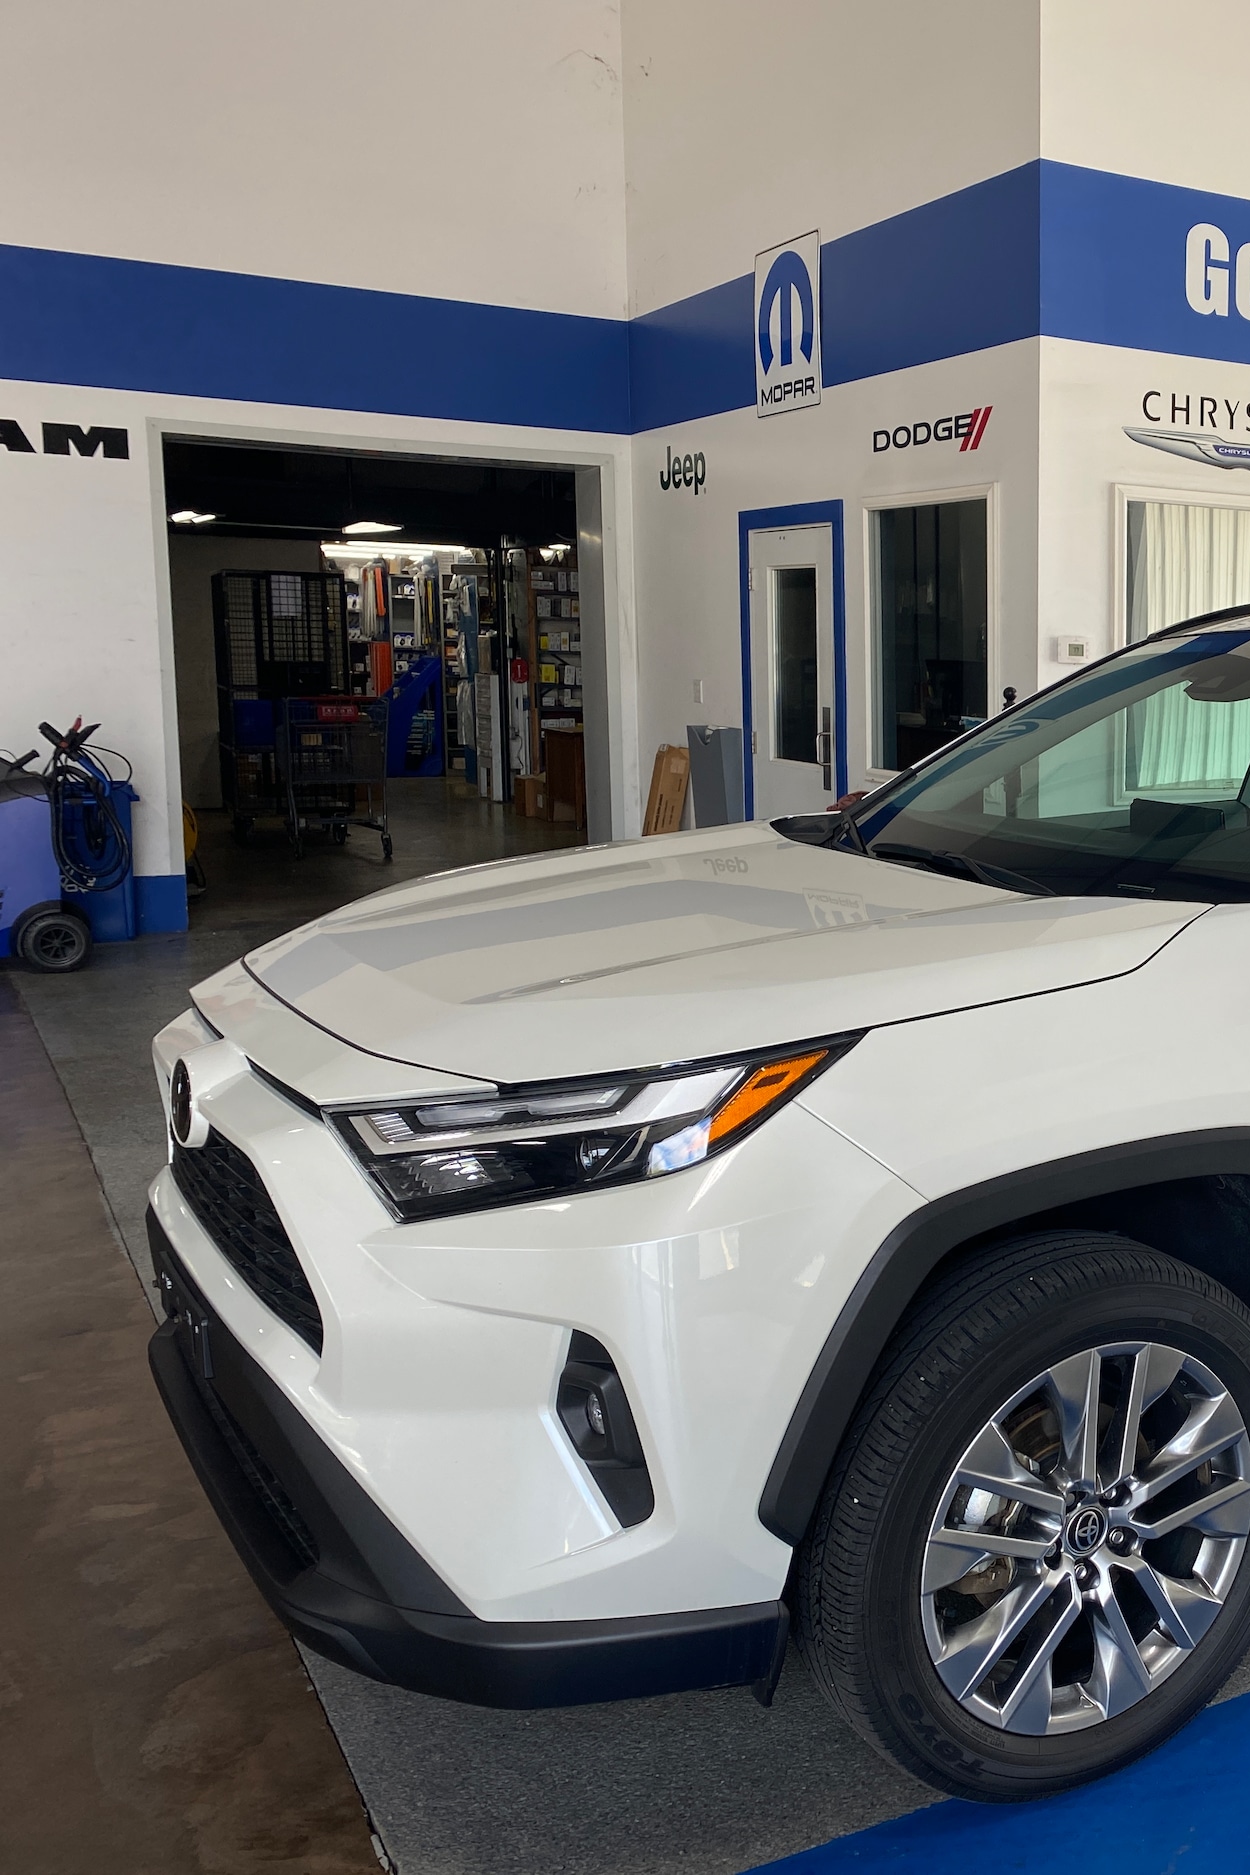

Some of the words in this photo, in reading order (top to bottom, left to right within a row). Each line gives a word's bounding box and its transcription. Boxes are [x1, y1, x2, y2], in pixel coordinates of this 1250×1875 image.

[760, 375, 816, 407] MOPAR
[873, 412, 974, 453] DODGE
[659, 445, 706, 496] Jeep
[897, 1691, 985, 1777] TOYO
